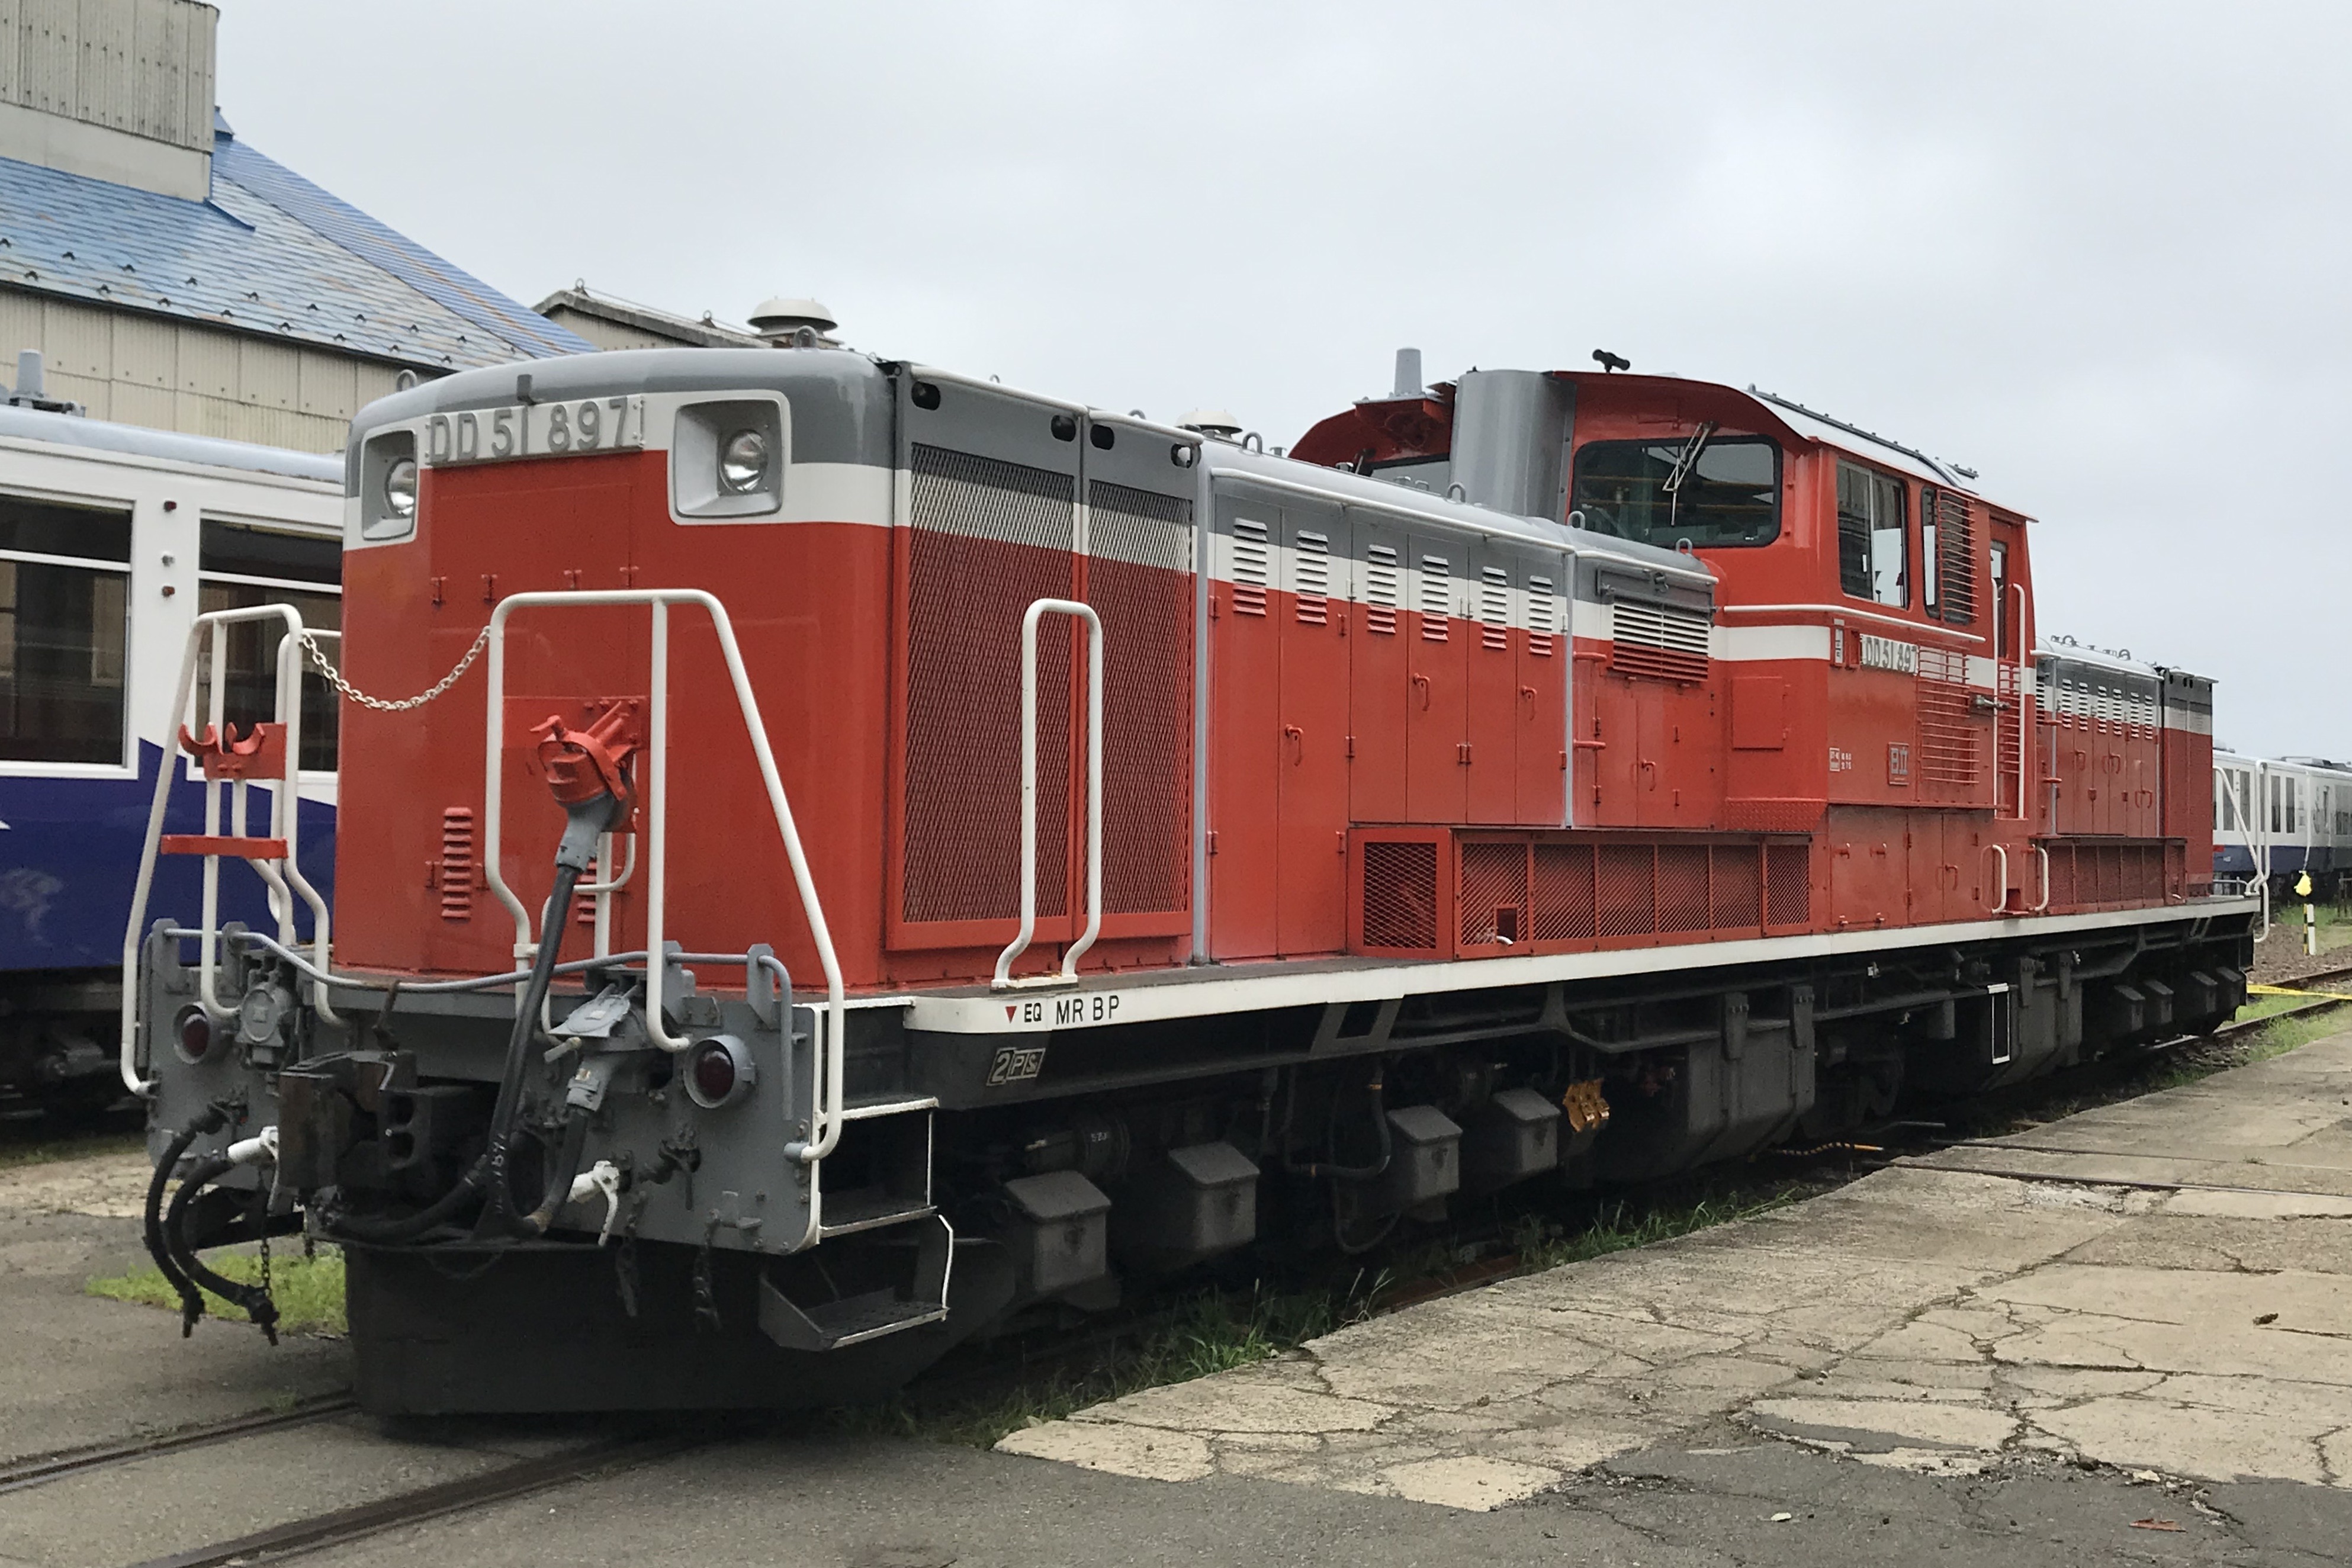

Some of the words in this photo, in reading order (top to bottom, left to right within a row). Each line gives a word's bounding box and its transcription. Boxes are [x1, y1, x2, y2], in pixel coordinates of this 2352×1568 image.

[547, 396, 628, 453] 897
[1897, 643, 1917, 673] 897
[1024, 1003, 1042, 1023] EQ
[1056, 998, 1083, 1024] MR
